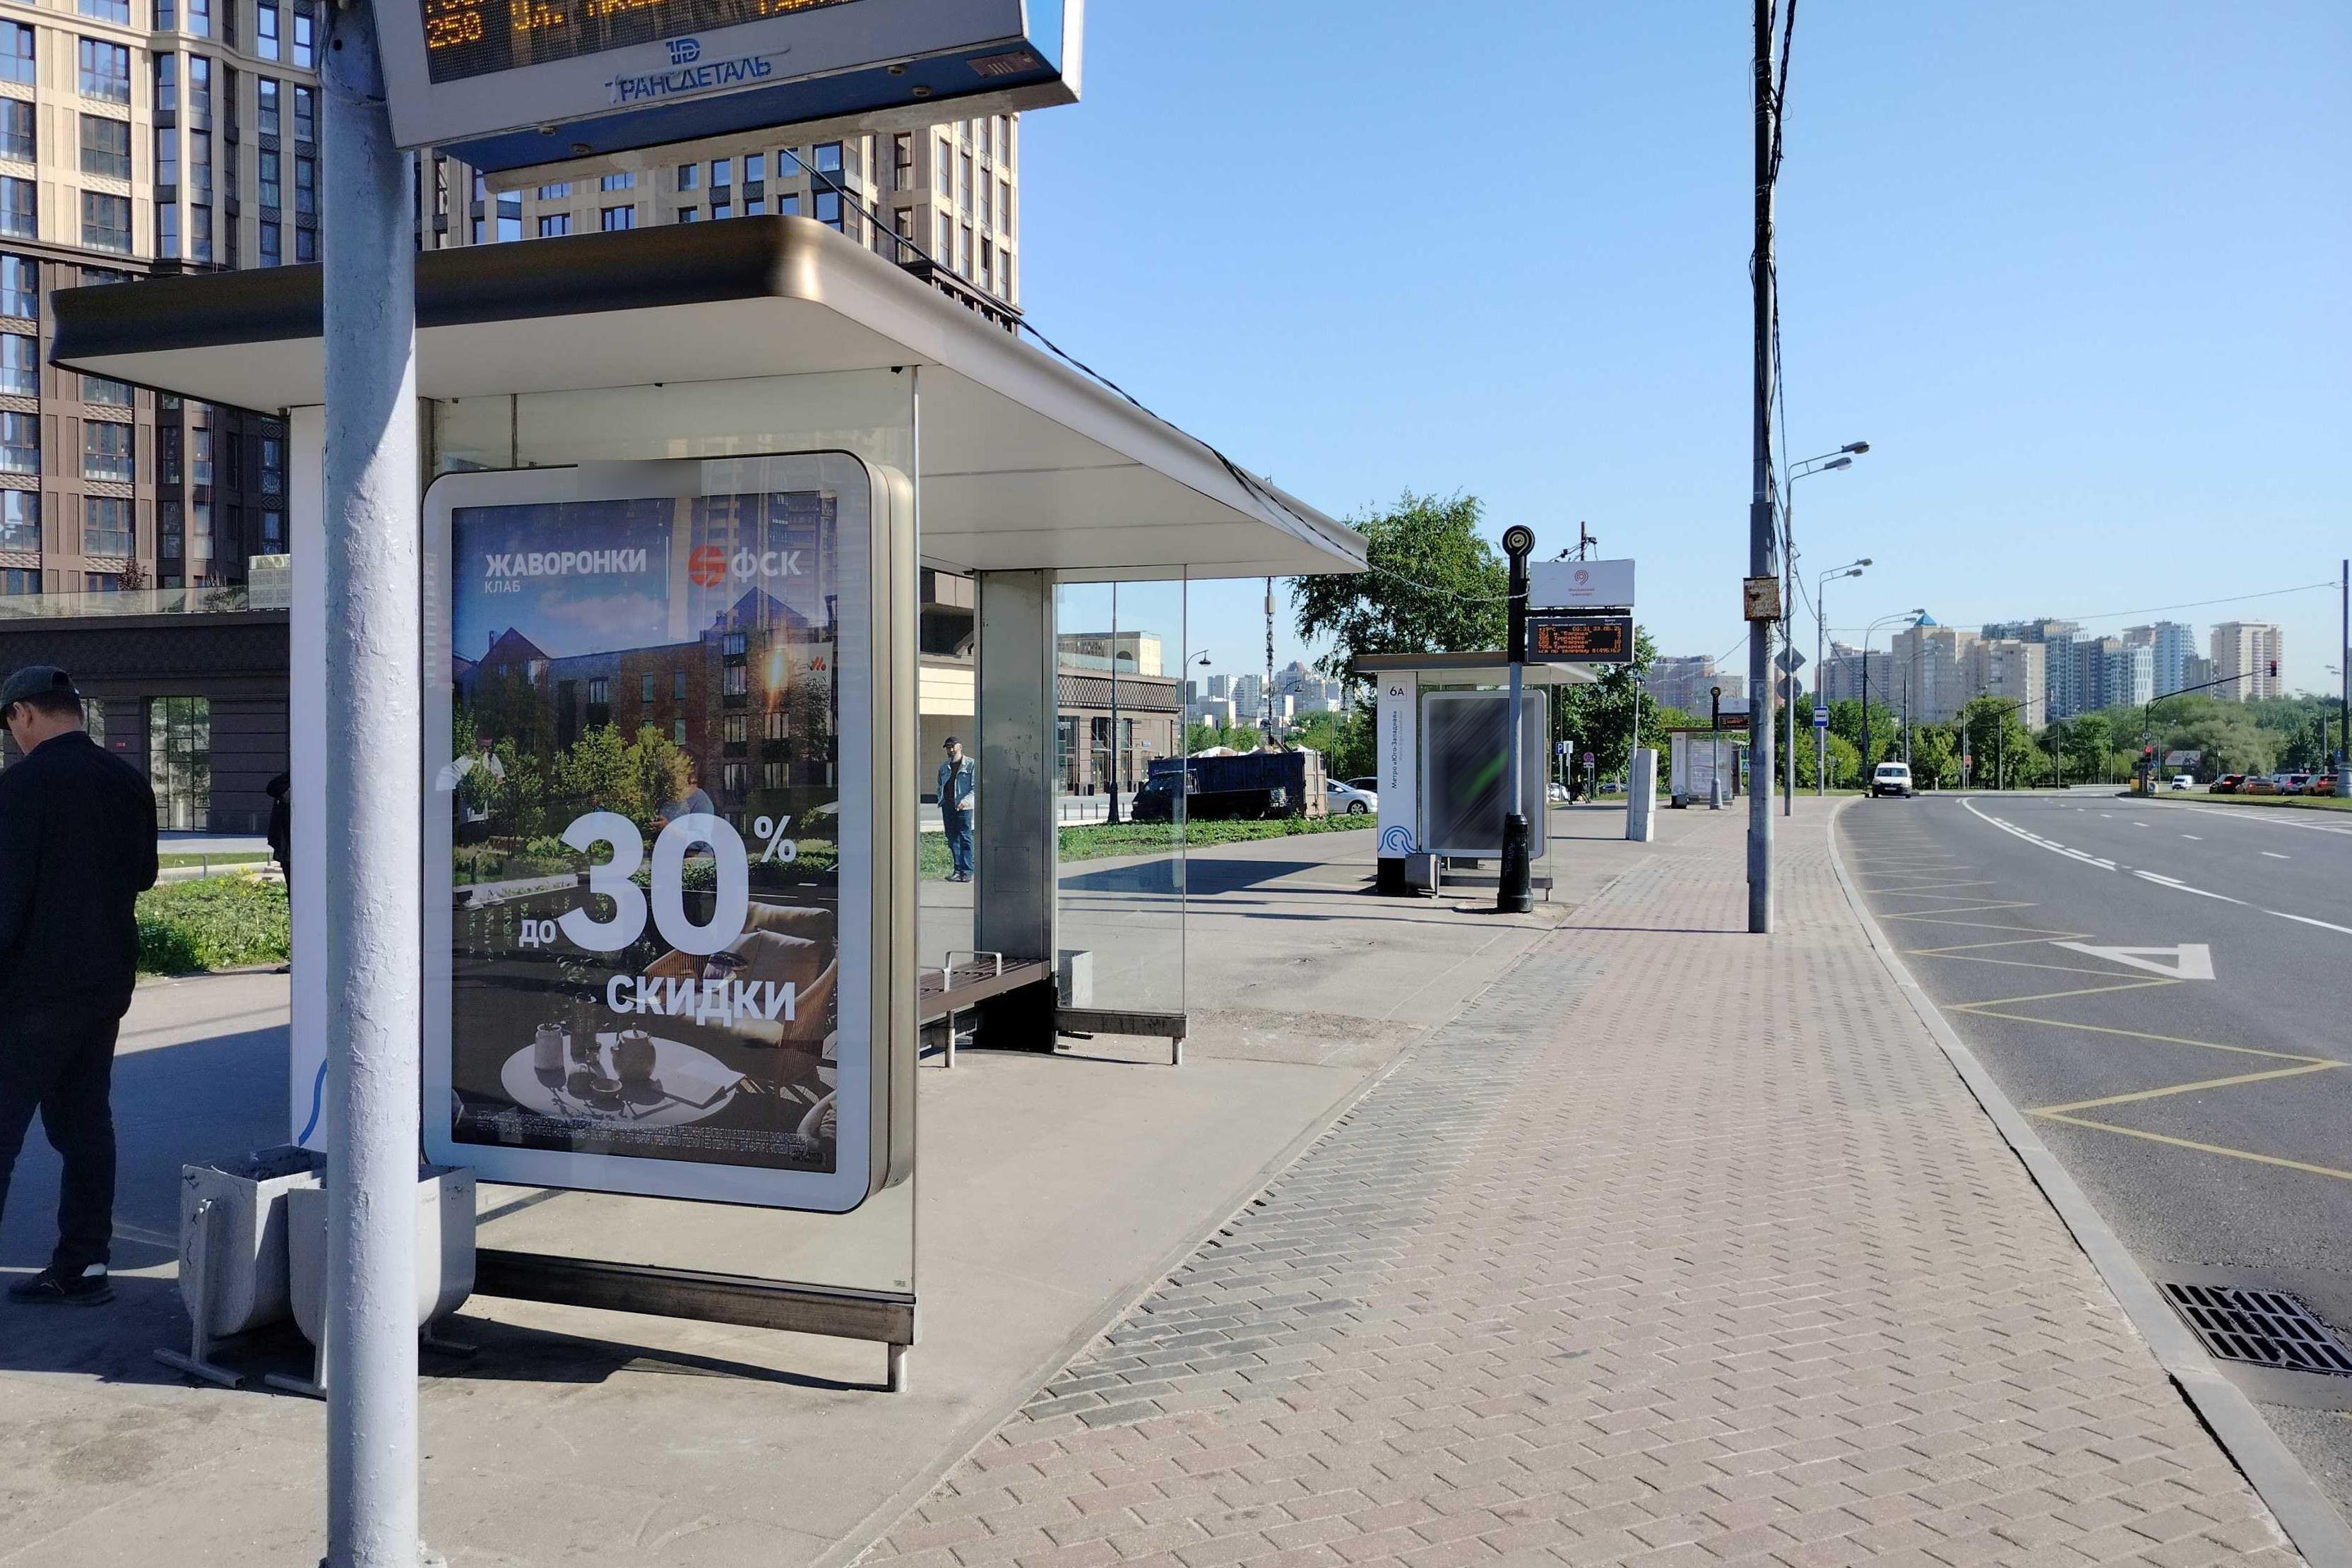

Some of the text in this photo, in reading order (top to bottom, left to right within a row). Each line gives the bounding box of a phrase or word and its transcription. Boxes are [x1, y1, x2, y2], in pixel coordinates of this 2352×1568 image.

[425, 12, 482, 47] 250
[605, 56, 771, 103] РАНСДЕТАЛЬ
[485, 549, 646, 577] ЖАВОРОНКИ
[731, 547, 802, 583] ФСК
[485, 581, 521, 593] КЛАБ
[1389, 686, 1405, 696] 6А
